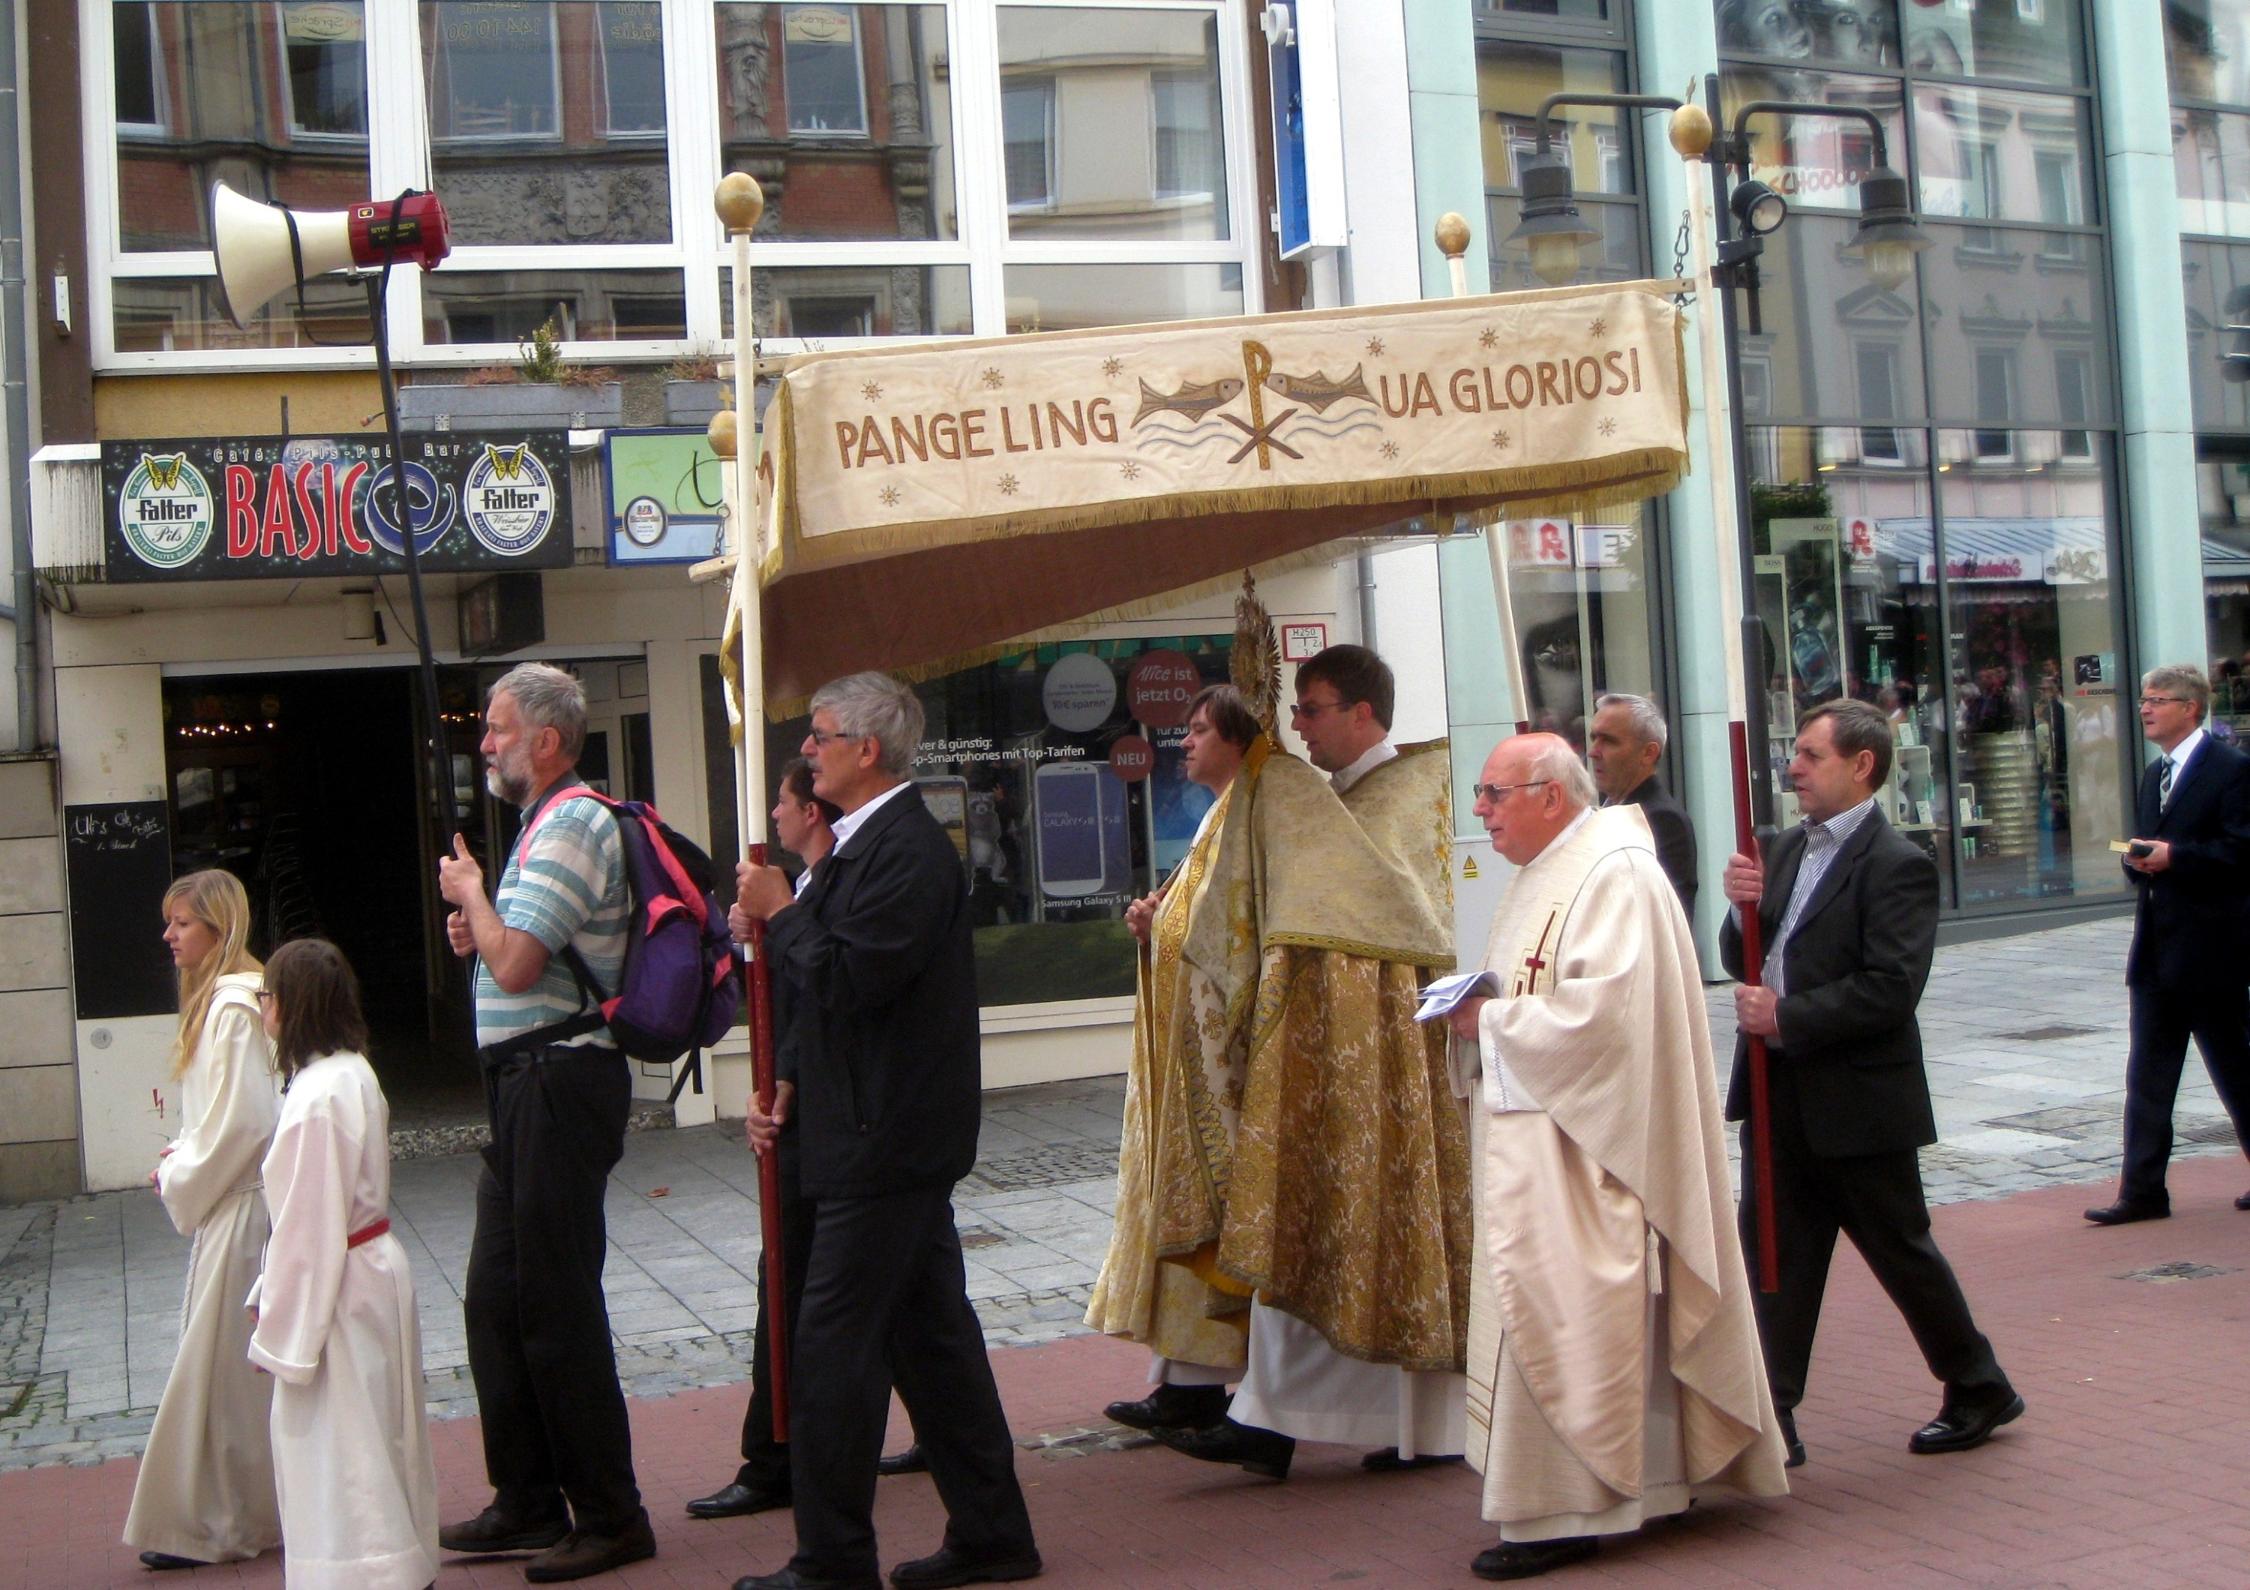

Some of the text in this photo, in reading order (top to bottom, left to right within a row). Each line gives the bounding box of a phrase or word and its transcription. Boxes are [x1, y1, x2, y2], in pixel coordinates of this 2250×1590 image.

[835, 347, 1641, 469] PANGE LING UA GLORIOSI
[214, 448, 263, 462] Café
[424, 443, 460, 457] Bar
[225, 461, 371, 561] BASIC
[151, 525, 182, 544] Pils
[1174, 665, 1192, 681] ist
[1136, 687, 1169, 705] jetzt
[912, 736, 992, 753] ver & günstig:
[1002, 749, 1021, 761] mit
[1023, 745, 1086, 761] Top-Tarifen
[1117, 753, 1146, 765] NEU
[1041, 898, 1082, 908] Samsung
[1083, 896, 1114, 906] Galaxy
